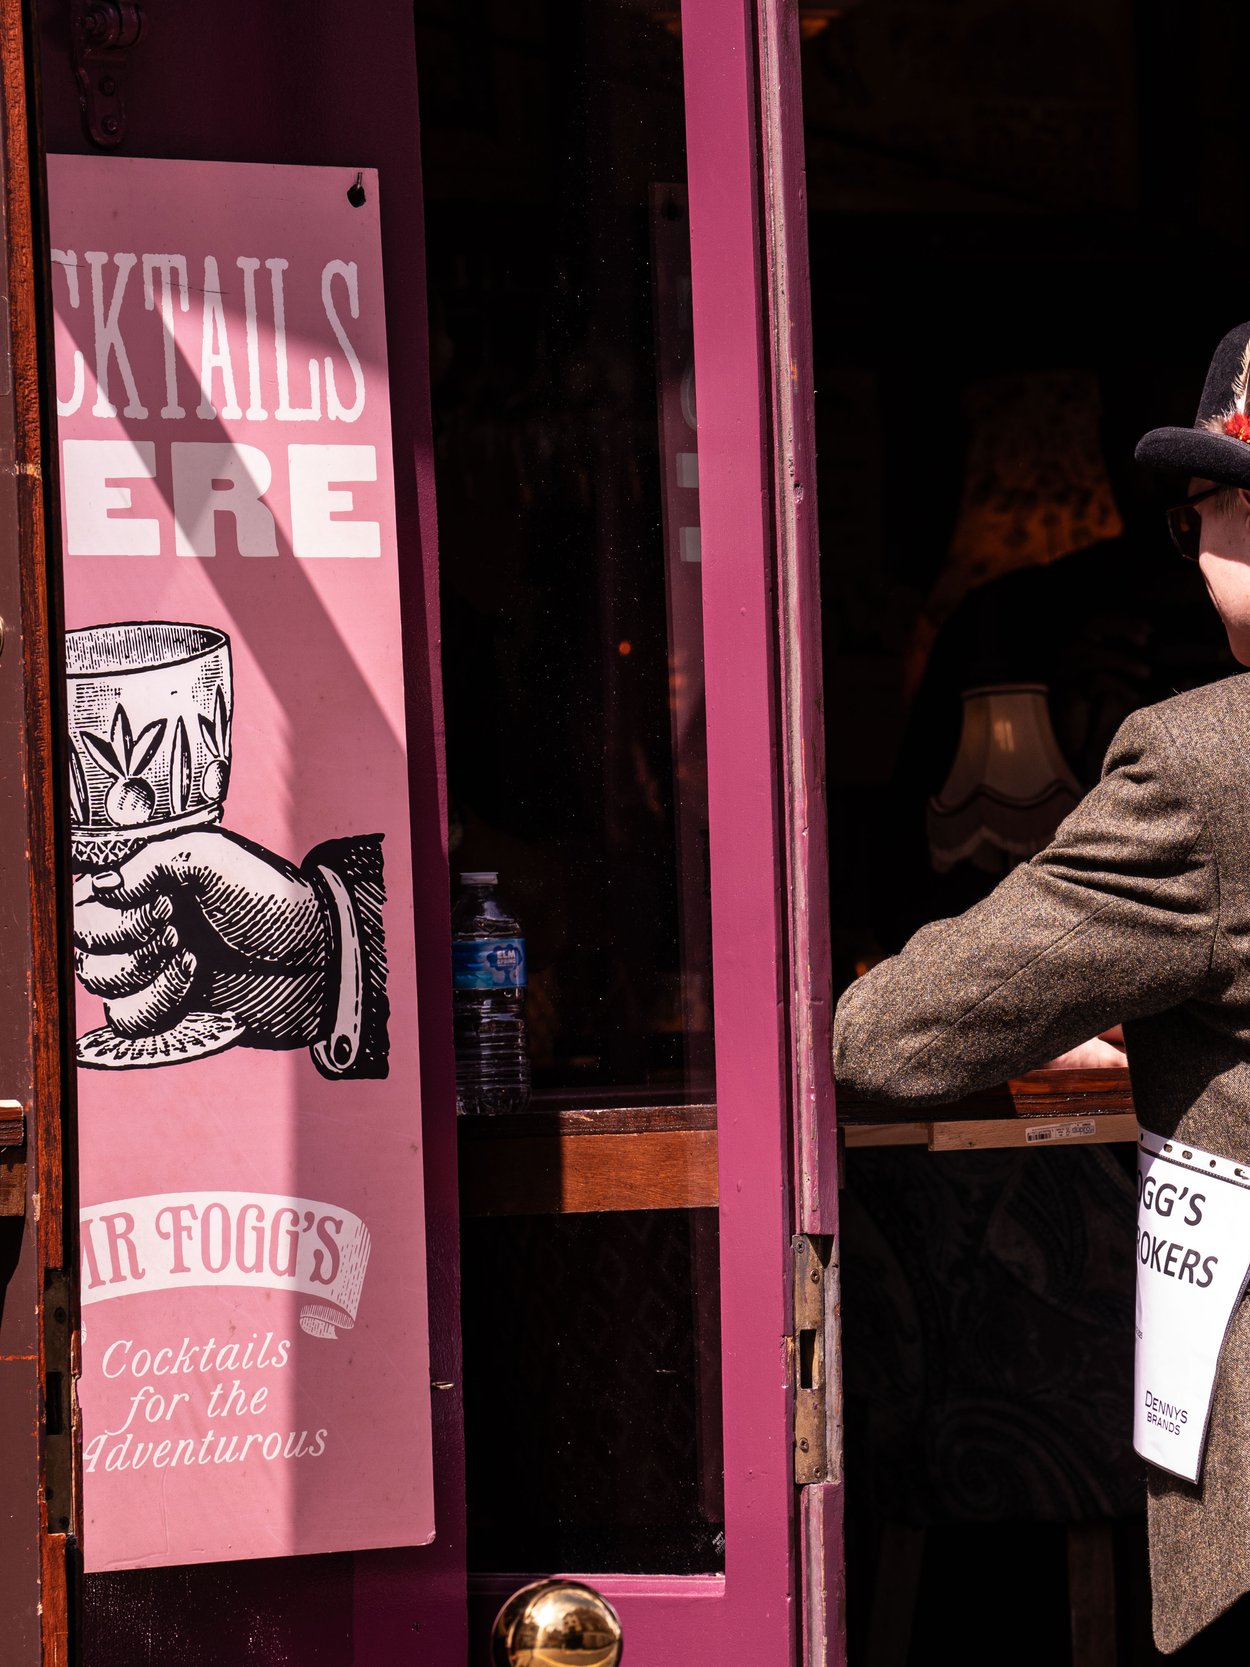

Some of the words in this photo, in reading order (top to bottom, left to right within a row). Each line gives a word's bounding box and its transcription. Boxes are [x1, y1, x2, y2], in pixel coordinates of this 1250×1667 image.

[62, 439, 381, 558] ERE
[155, 1202, 344, 1286] FOGG'S
[102, 1332, 292, 1378] Cocktails
[104, 1384, 190, 1435] for
[206, 1380, 269, 1418] the
[1145, 1390, 1188, 1424] DENNYS
[1147, 1411, 1181, 1436] BRANDS
